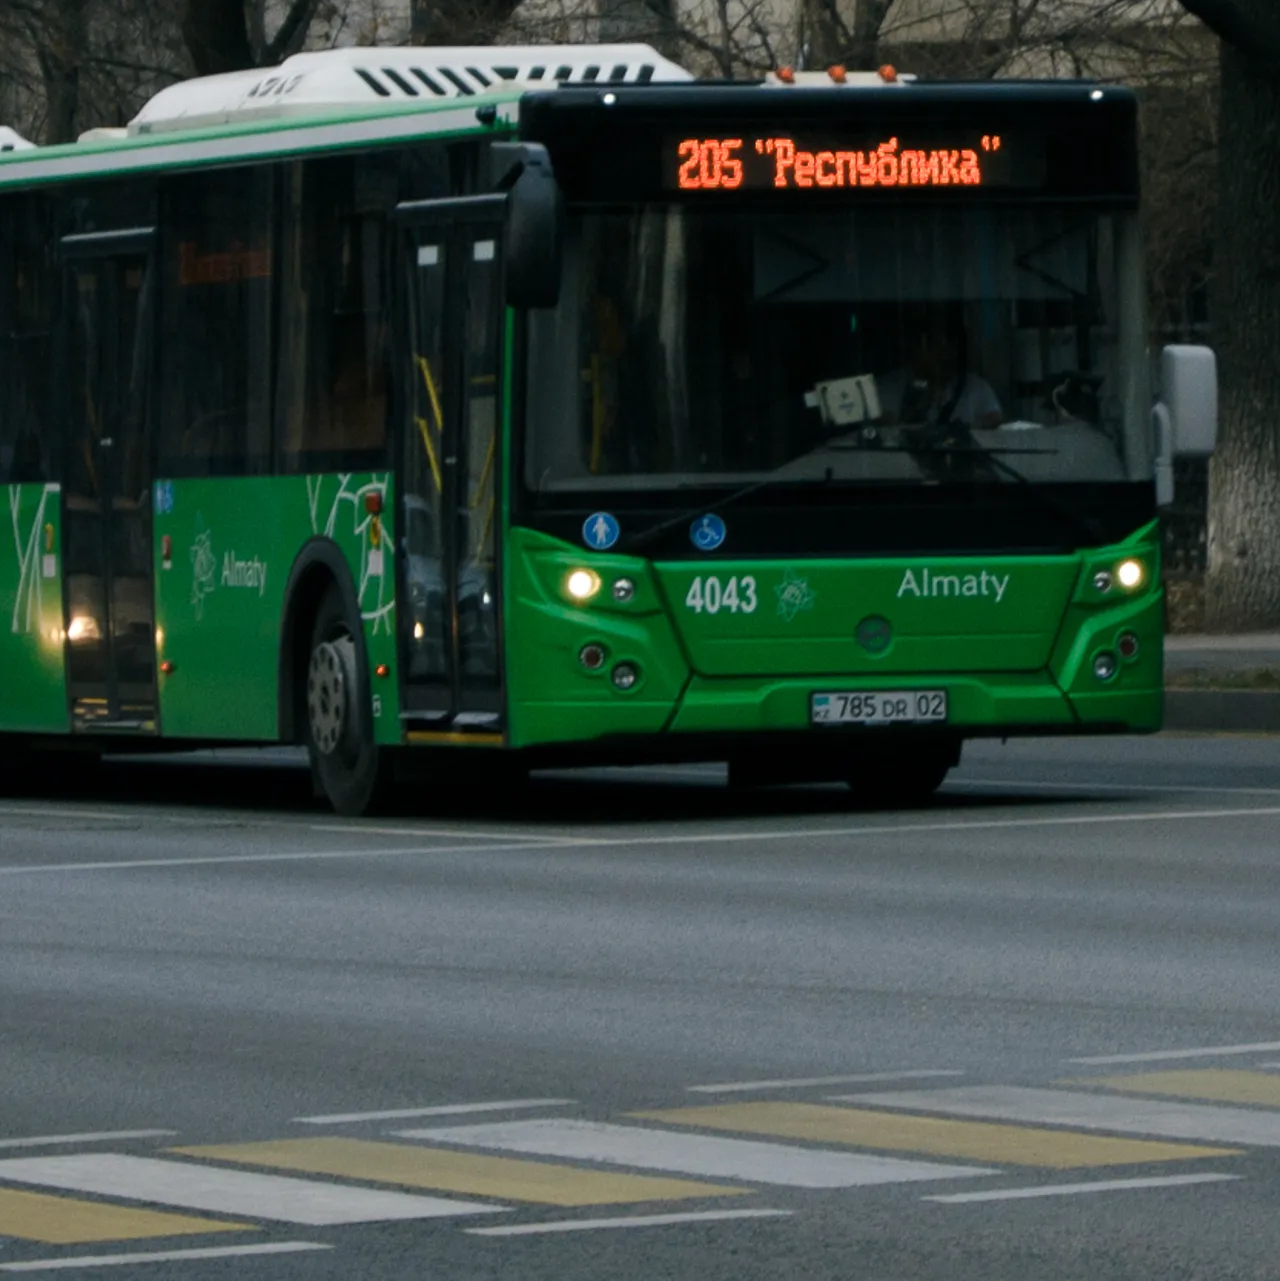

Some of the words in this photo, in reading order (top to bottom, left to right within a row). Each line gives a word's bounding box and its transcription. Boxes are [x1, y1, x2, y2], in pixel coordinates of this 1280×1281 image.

[678, 138, 743, 189] 205
[754, 135, 1001, 187] "Республика"
[220, 549, 267, 598] Almaty
[896, 568, 1010, 604] Almaty
[685, 575, 758, 614] 4043
[835, 694, 877, 719] 785
[882, 698, 908, 718] DR
[916, 693, 945, 717] 02
